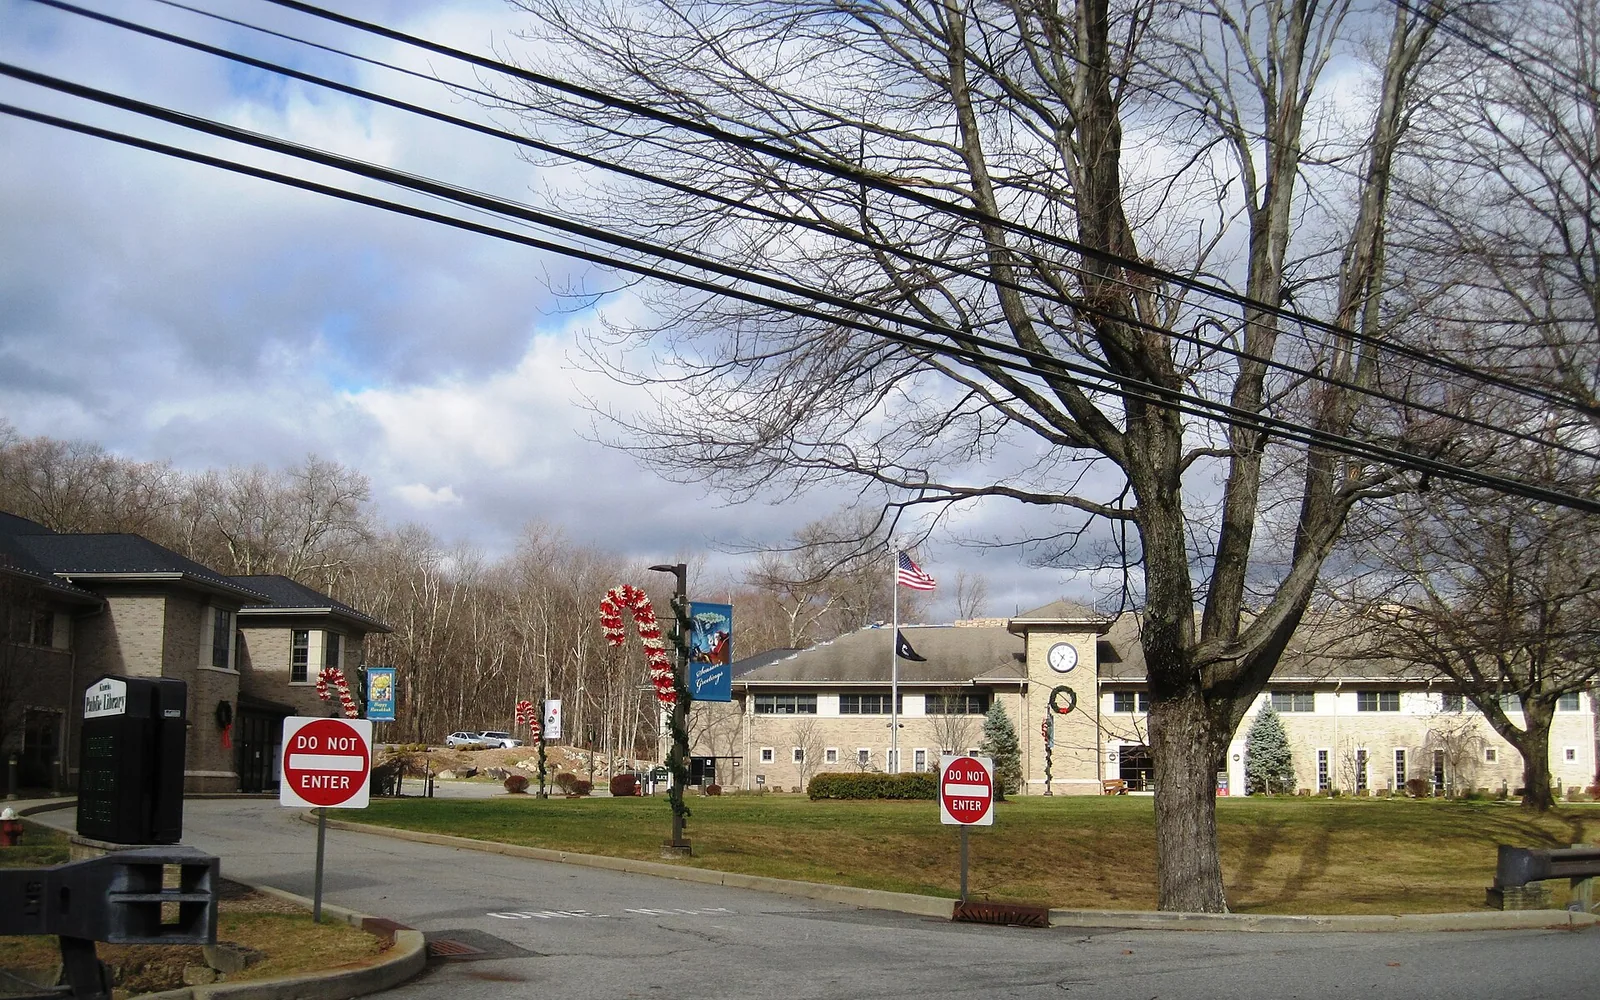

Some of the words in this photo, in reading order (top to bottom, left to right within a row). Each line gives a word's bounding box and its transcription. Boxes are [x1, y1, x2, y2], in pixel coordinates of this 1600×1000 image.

[695, 671, 724, 693] Greetings
[86, 695, 102, 712] Public
[103, 693, 126, 712] Library
[297, 736, 318, 749] DO
[327, 737, 357, 751] NOT
[301, 775, 349, 789] ENTER
[949, 770, 962, 780] DO
[966, 771, 985, 781] NOT
[952, 800, 982, 811] ENTER
